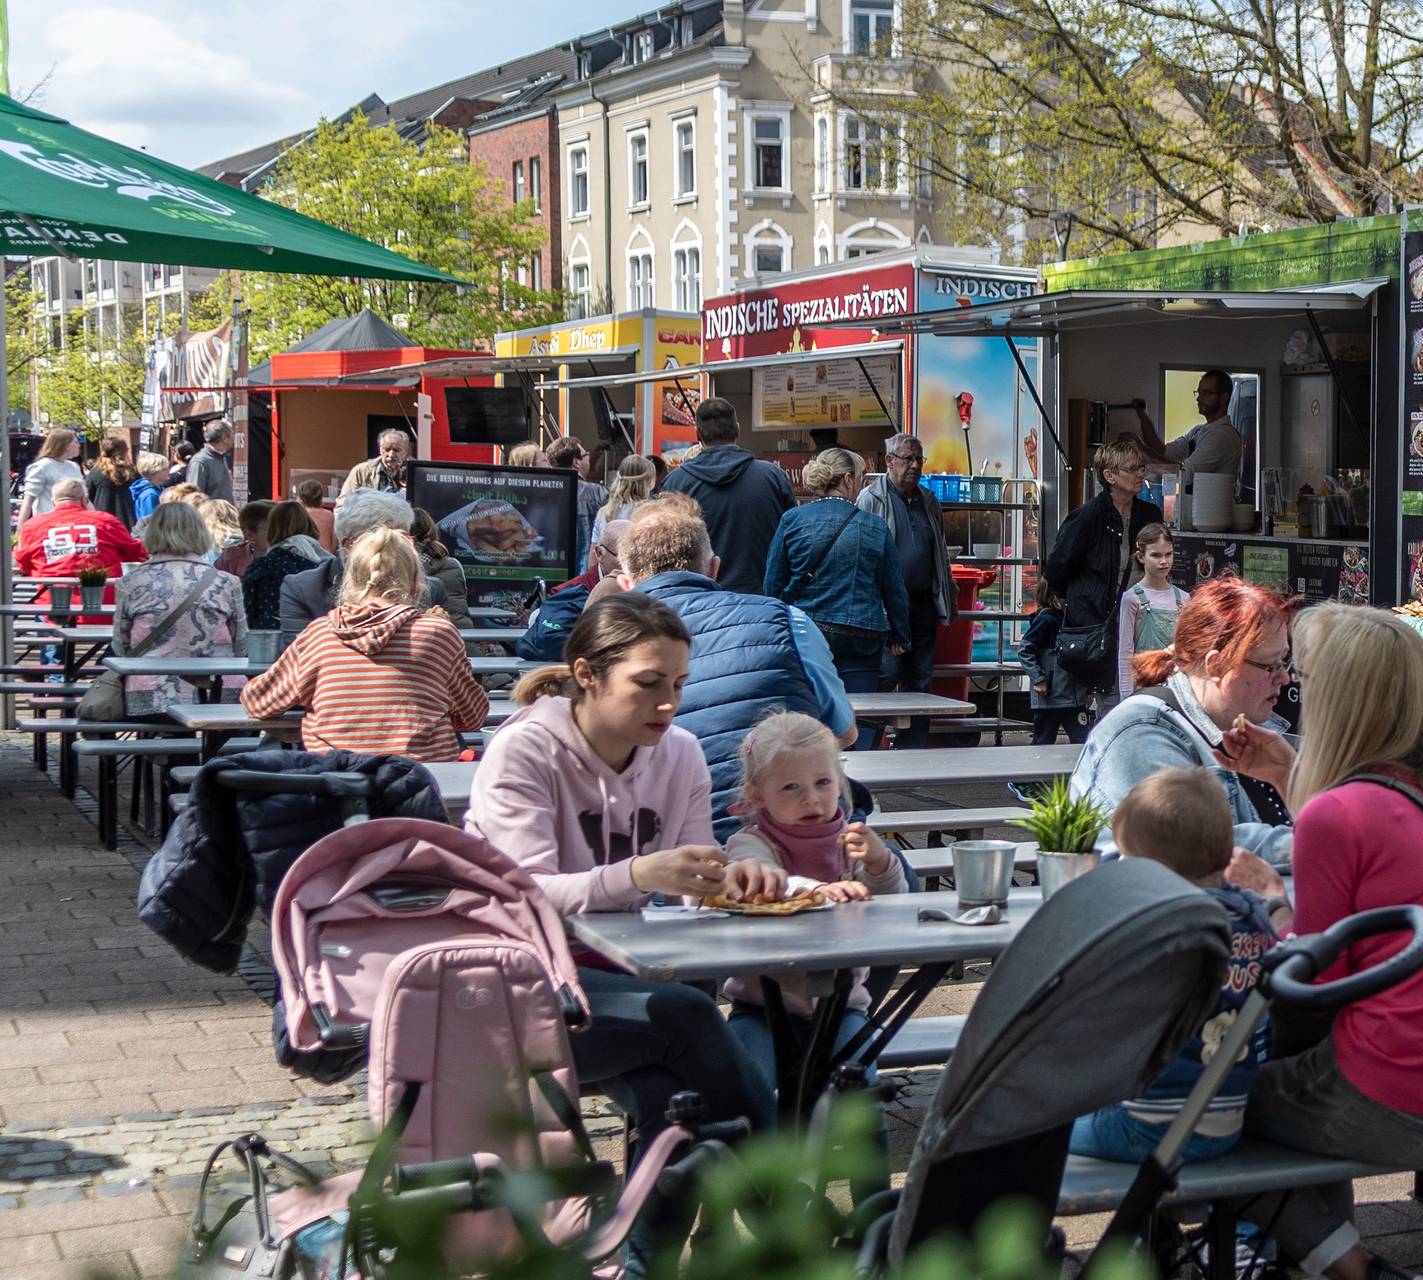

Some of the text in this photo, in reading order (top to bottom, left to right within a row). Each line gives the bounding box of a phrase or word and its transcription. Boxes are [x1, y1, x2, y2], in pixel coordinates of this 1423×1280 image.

[704, 284, 908, 340] INDISCHE SPEZIALITÄTEN
[426, 473, 564, 489] DIE BESTEN POMMES AUF DIESEM PLANETEN
[47, 524, 98, 549] 63
